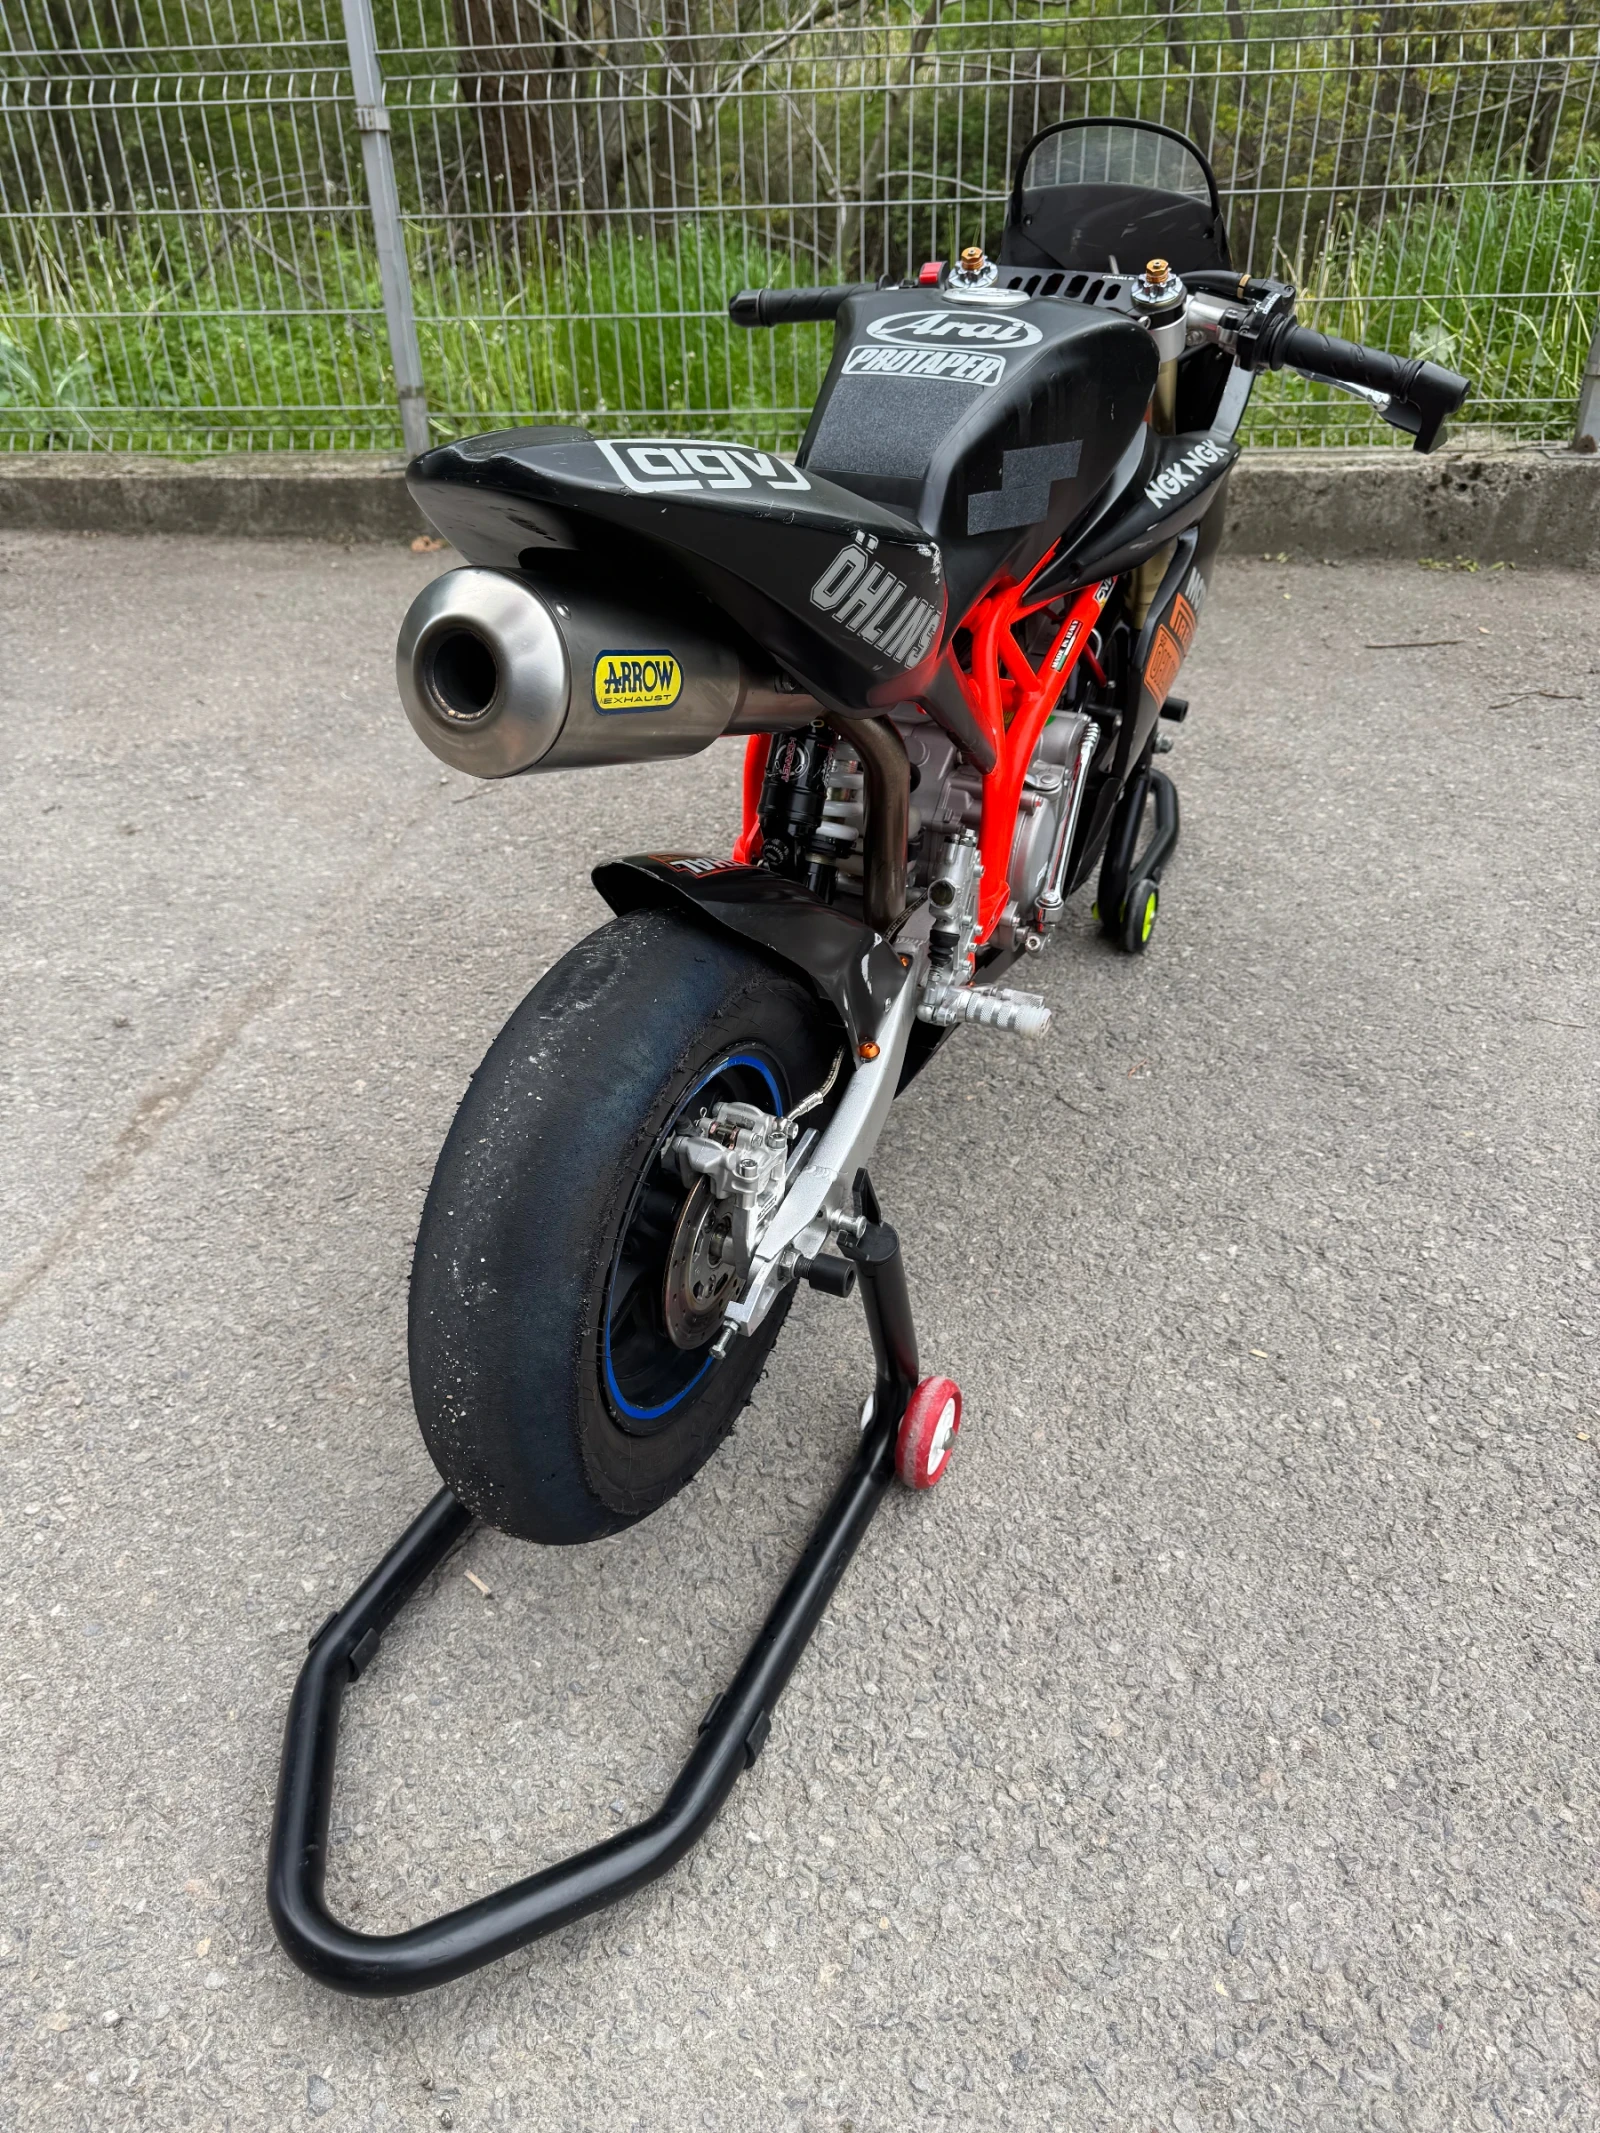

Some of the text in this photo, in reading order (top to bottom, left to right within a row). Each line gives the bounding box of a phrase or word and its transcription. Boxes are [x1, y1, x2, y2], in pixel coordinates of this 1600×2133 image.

[875, 314, 1026, 341] Arai
[850, 348, 1002, 383] PROTAPER
[1144, 439, 1229, 509] NGK NGK
[810, 529, 942, 669] ÖHLINS
[603, 660, 674, 694] ARROW
[603, 694, 672, 705] EXHAUST
